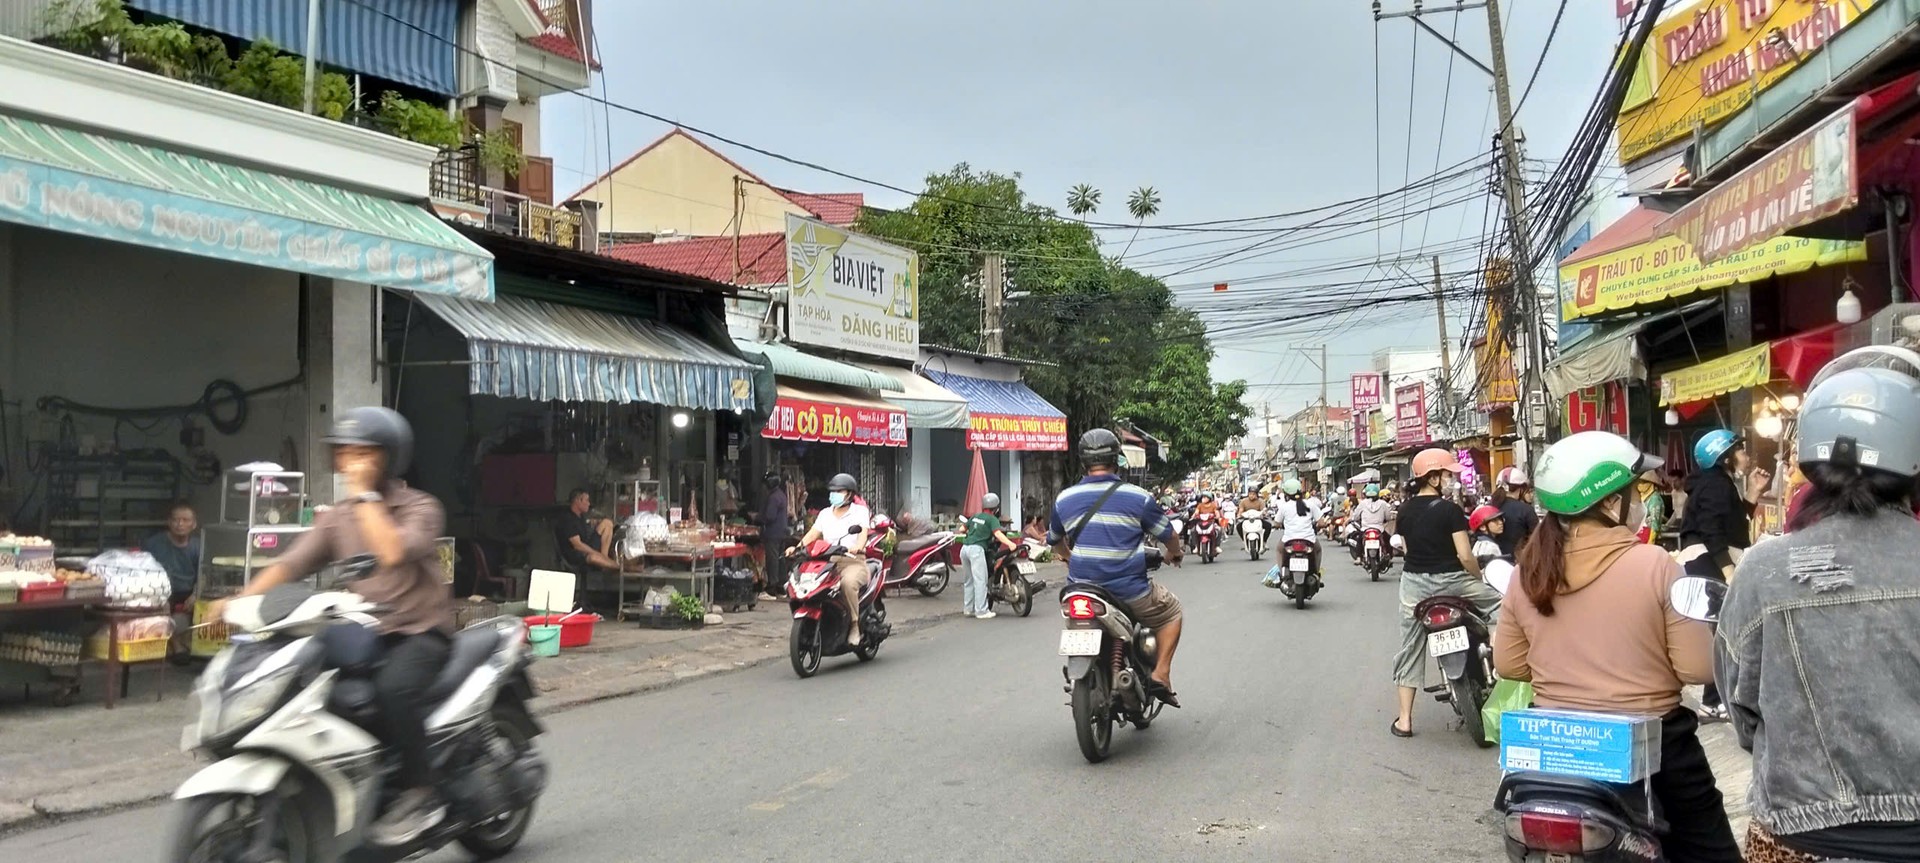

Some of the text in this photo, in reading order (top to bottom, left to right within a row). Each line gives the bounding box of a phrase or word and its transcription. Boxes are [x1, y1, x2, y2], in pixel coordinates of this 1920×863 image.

[1663, 5, 1728, 68] TRÂU
[1701, 49, 1752, 97] KHOA
[152, 204, 281, 258] NGUYÊN
[1600, 258, 1627, 281] TRÂU
[1630, 252, 1645, 274] TƠ
[1653, 245, 1668, 268] BÒ
[1601, 280, 1634, 294] CHUYÊN
[1637, 273, 1660, 285] CUNG
[1662, 267, 1679, 279] CẤP
[1776, 237, 1790, 253] BÒ
[1616, 287, 1654, 302] Website:
[841, 312, 881, 337] ĐĂNG
[885, 321, 914, 344] HIẾU
[781, 405, 794, 432] HEO
[797, 405, 819, 435] CÔ
[821, 406, 853, 437] HẢO
[990, 416, 1020, 432] TRỨNG
[1594, 469, 1622, 490] Manulife
[1434, 629, 1461, 643] 36-B3
[1518, 719, 1540, 733] TH
[1534, 806, 1568, 816] HONDA
